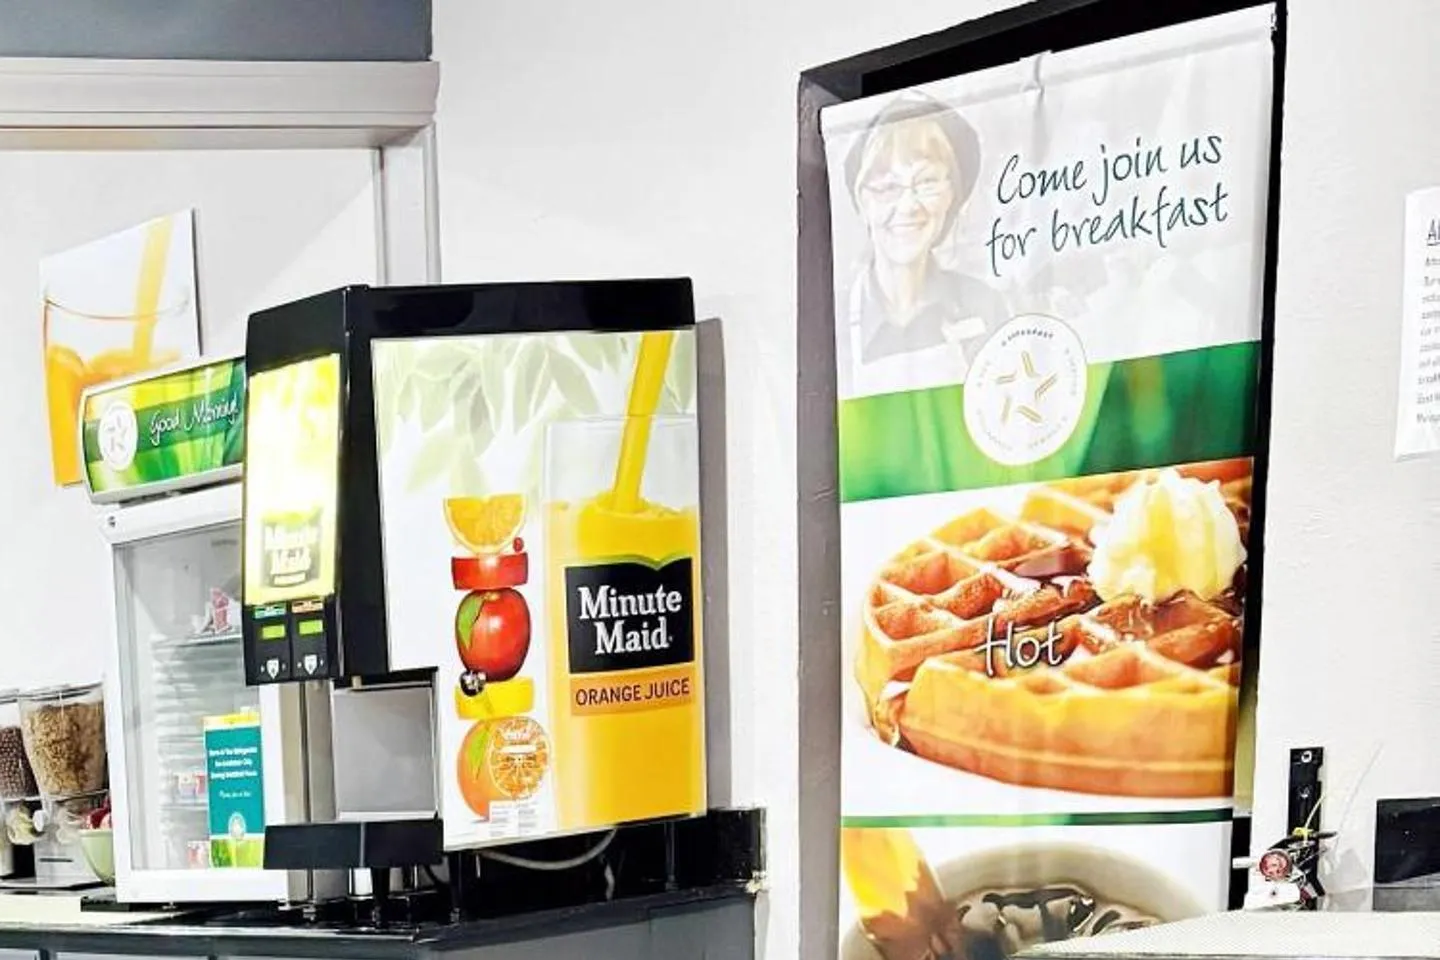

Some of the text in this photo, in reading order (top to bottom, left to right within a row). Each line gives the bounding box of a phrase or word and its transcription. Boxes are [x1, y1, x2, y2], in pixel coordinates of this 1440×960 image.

[997, 135, 1222, 206] Come join us
[985, 182, 1229, 277] for breakfast
[150, 408, 180, 446] Good
[577, 584, 682, 619] Minute
[594, 616, 670, 655] Maid
[973, 614, 1063, 676] Hot
[576, 678, 690, 706] ORANGE JUICE
